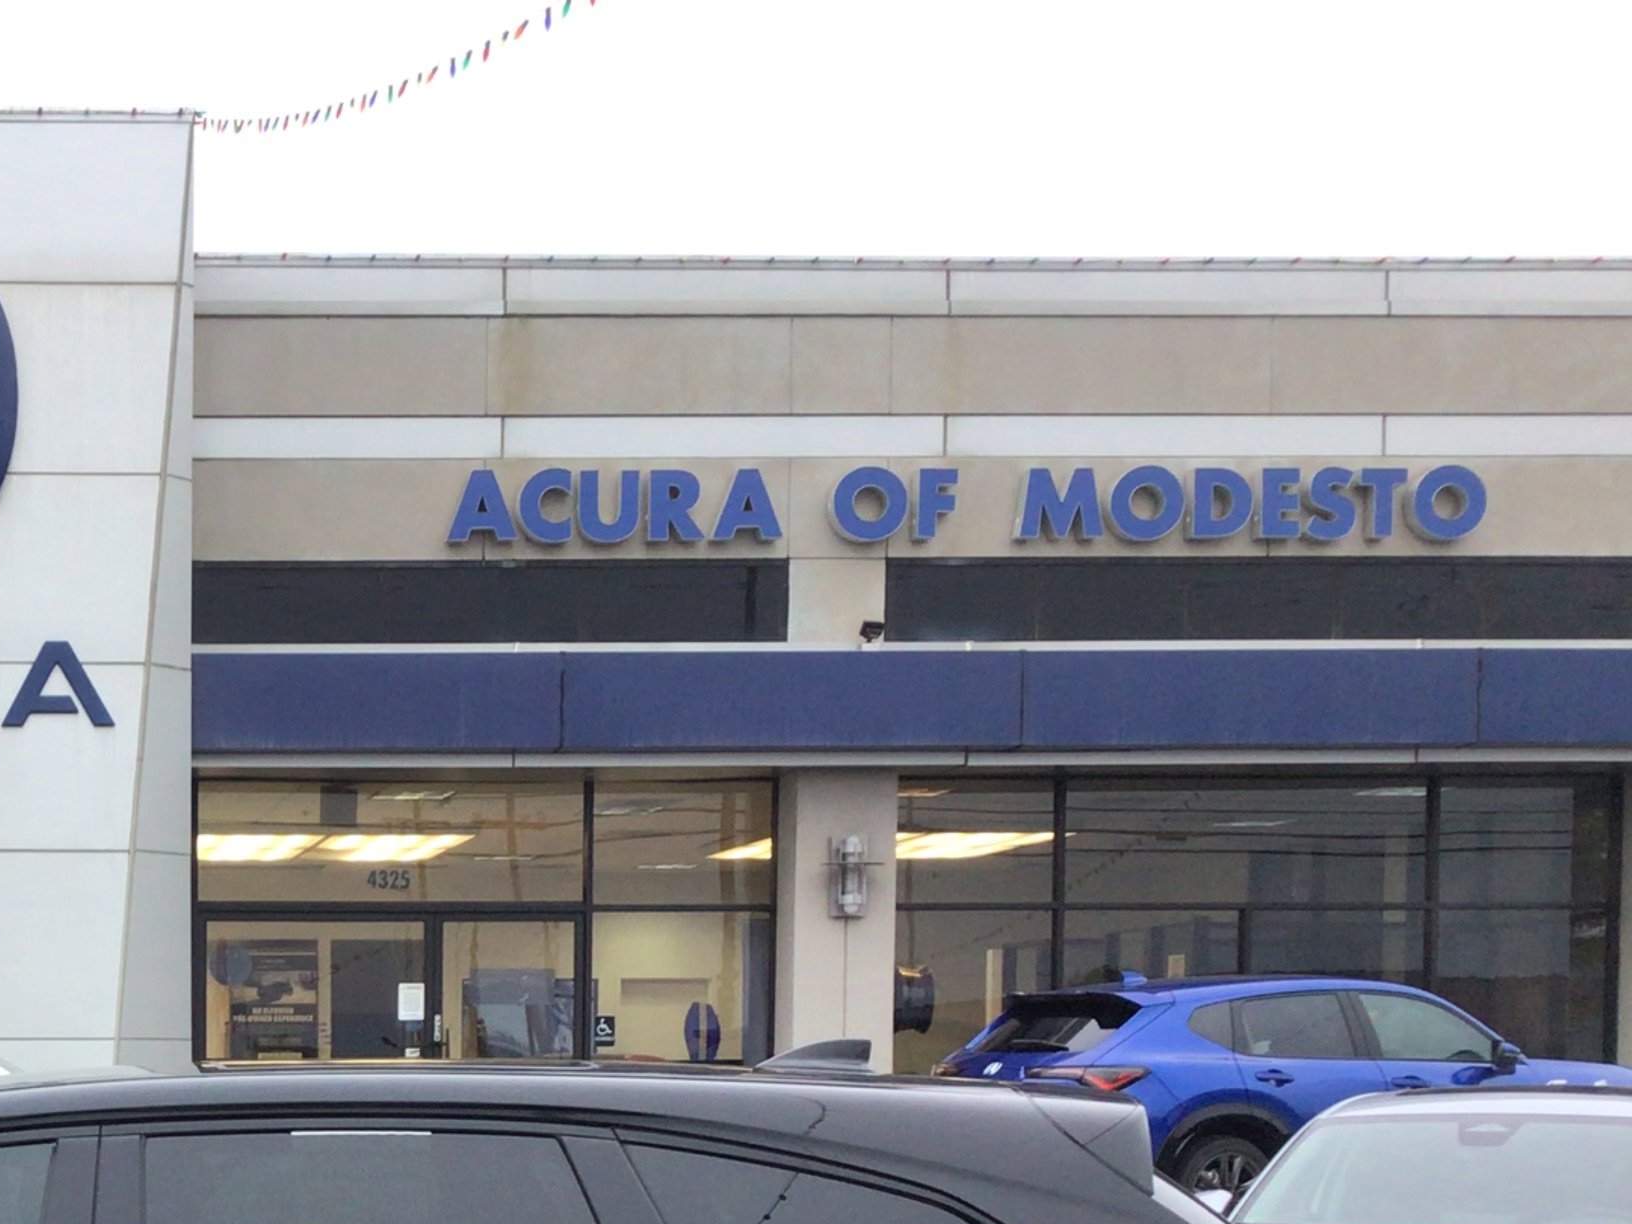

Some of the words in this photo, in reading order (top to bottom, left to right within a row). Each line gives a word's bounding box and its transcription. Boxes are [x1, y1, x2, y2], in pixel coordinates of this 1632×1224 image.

[446, 466, 783, 545] ACURA
[828, 465, 959, 544] OF
[1014, 464, 1488, 543] MODESTO
[367, 869, 411, 890] 4325
